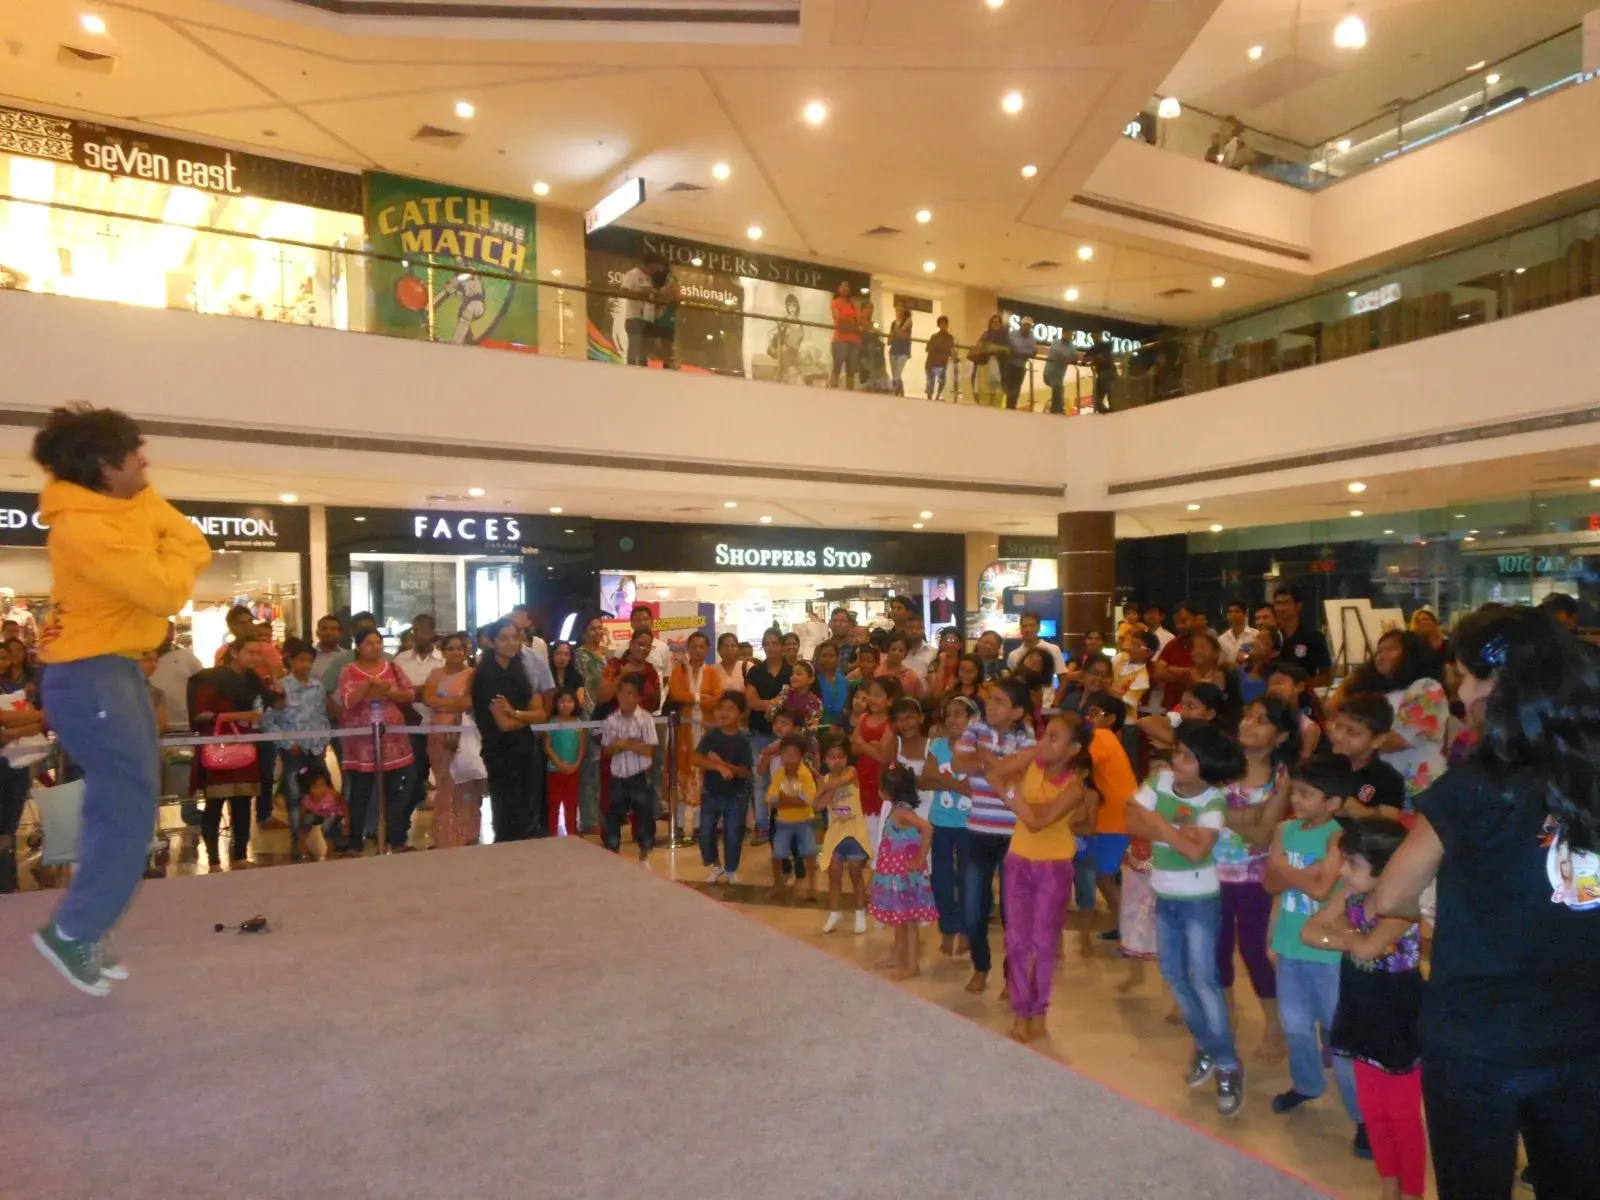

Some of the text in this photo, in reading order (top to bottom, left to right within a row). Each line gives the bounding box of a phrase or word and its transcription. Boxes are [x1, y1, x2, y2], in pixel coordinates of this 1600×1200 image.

[176, 152, 242, 193] east
[378, 196, 490, 235] CATCH
[401, 229, 526, 273] MATCH
[768, 259, 822, 287] STOP
[187, 516, 278, 537] NETTON.
[414, 516, 522, 541] FACES
[715, 543, 872, 569] SHOPPERS STOP
